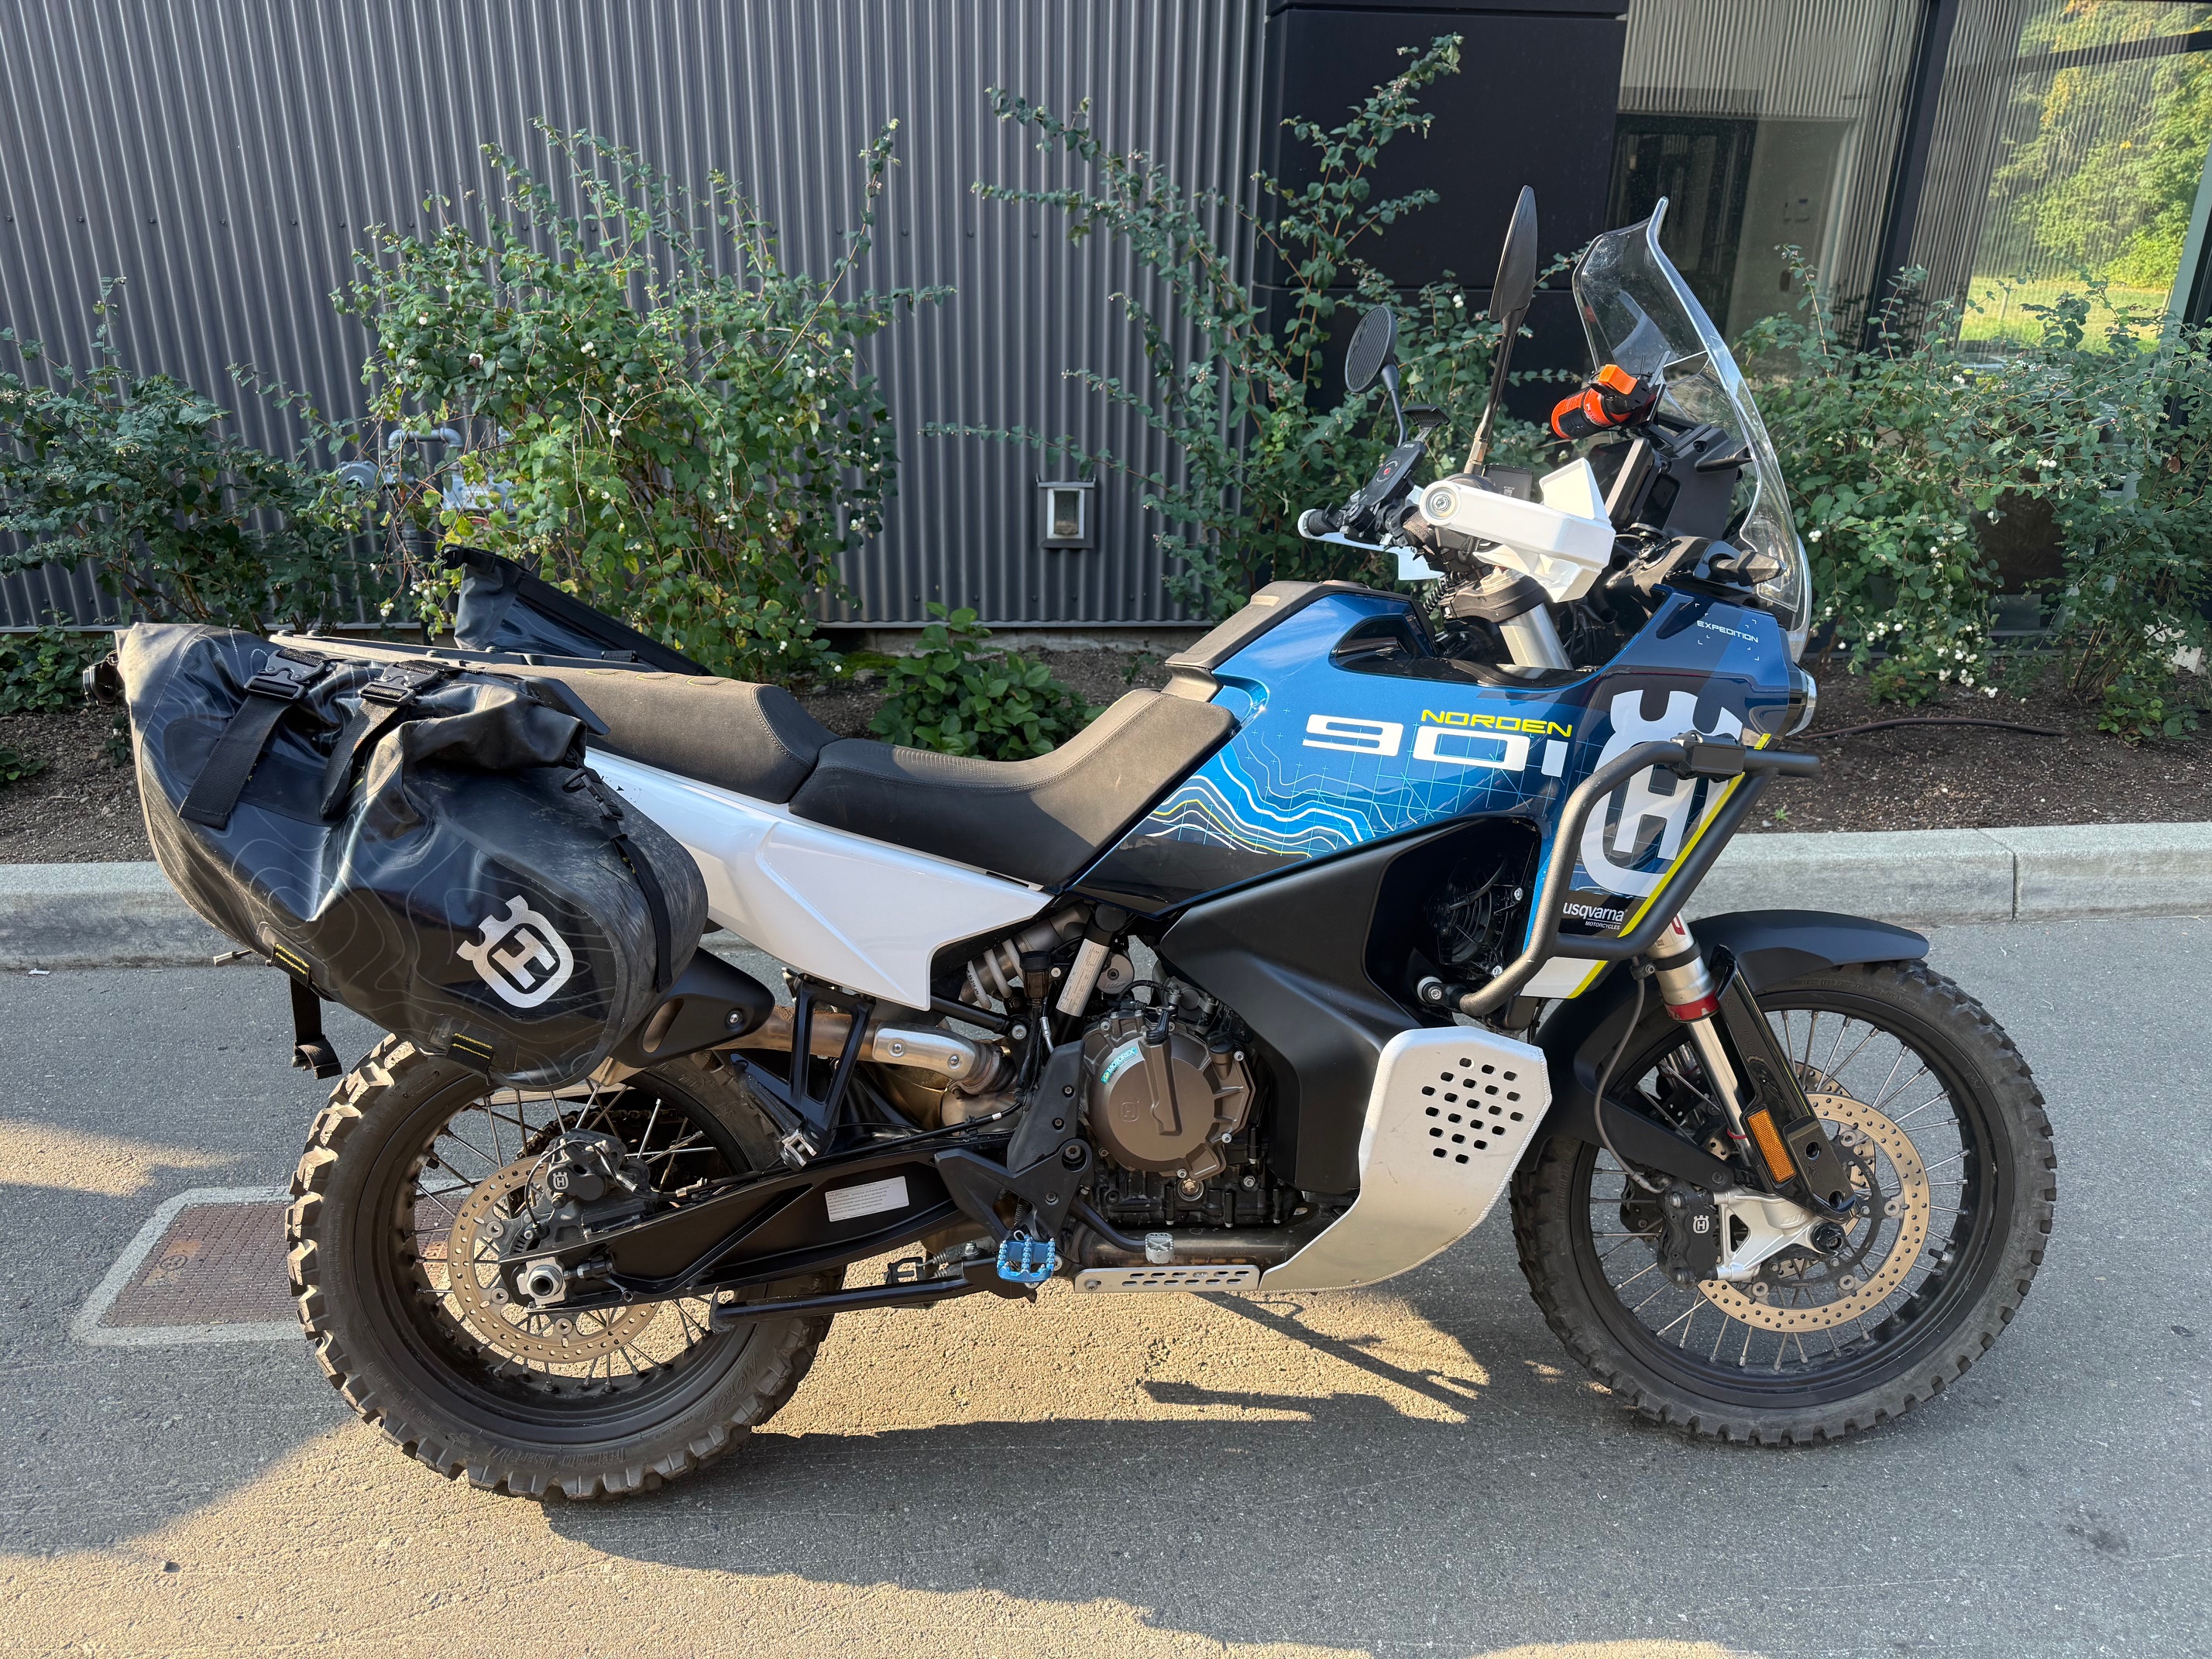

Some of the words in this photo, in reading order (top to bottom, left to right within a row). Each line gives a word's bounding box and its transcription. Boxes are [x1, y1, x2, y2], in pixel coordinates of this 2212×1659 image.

[1697, 620, 1758, 643] EXPEDITION
[1421, 709, 1572, 737] NORDEN
[1302, 714, 1568, 778] 901
[1563, 902, 1625, 922] usqvarna
[1585, 920, 1620, 930] MOTORCYCLES
[1107, 1048, 1135, 1073] MOTOREX
